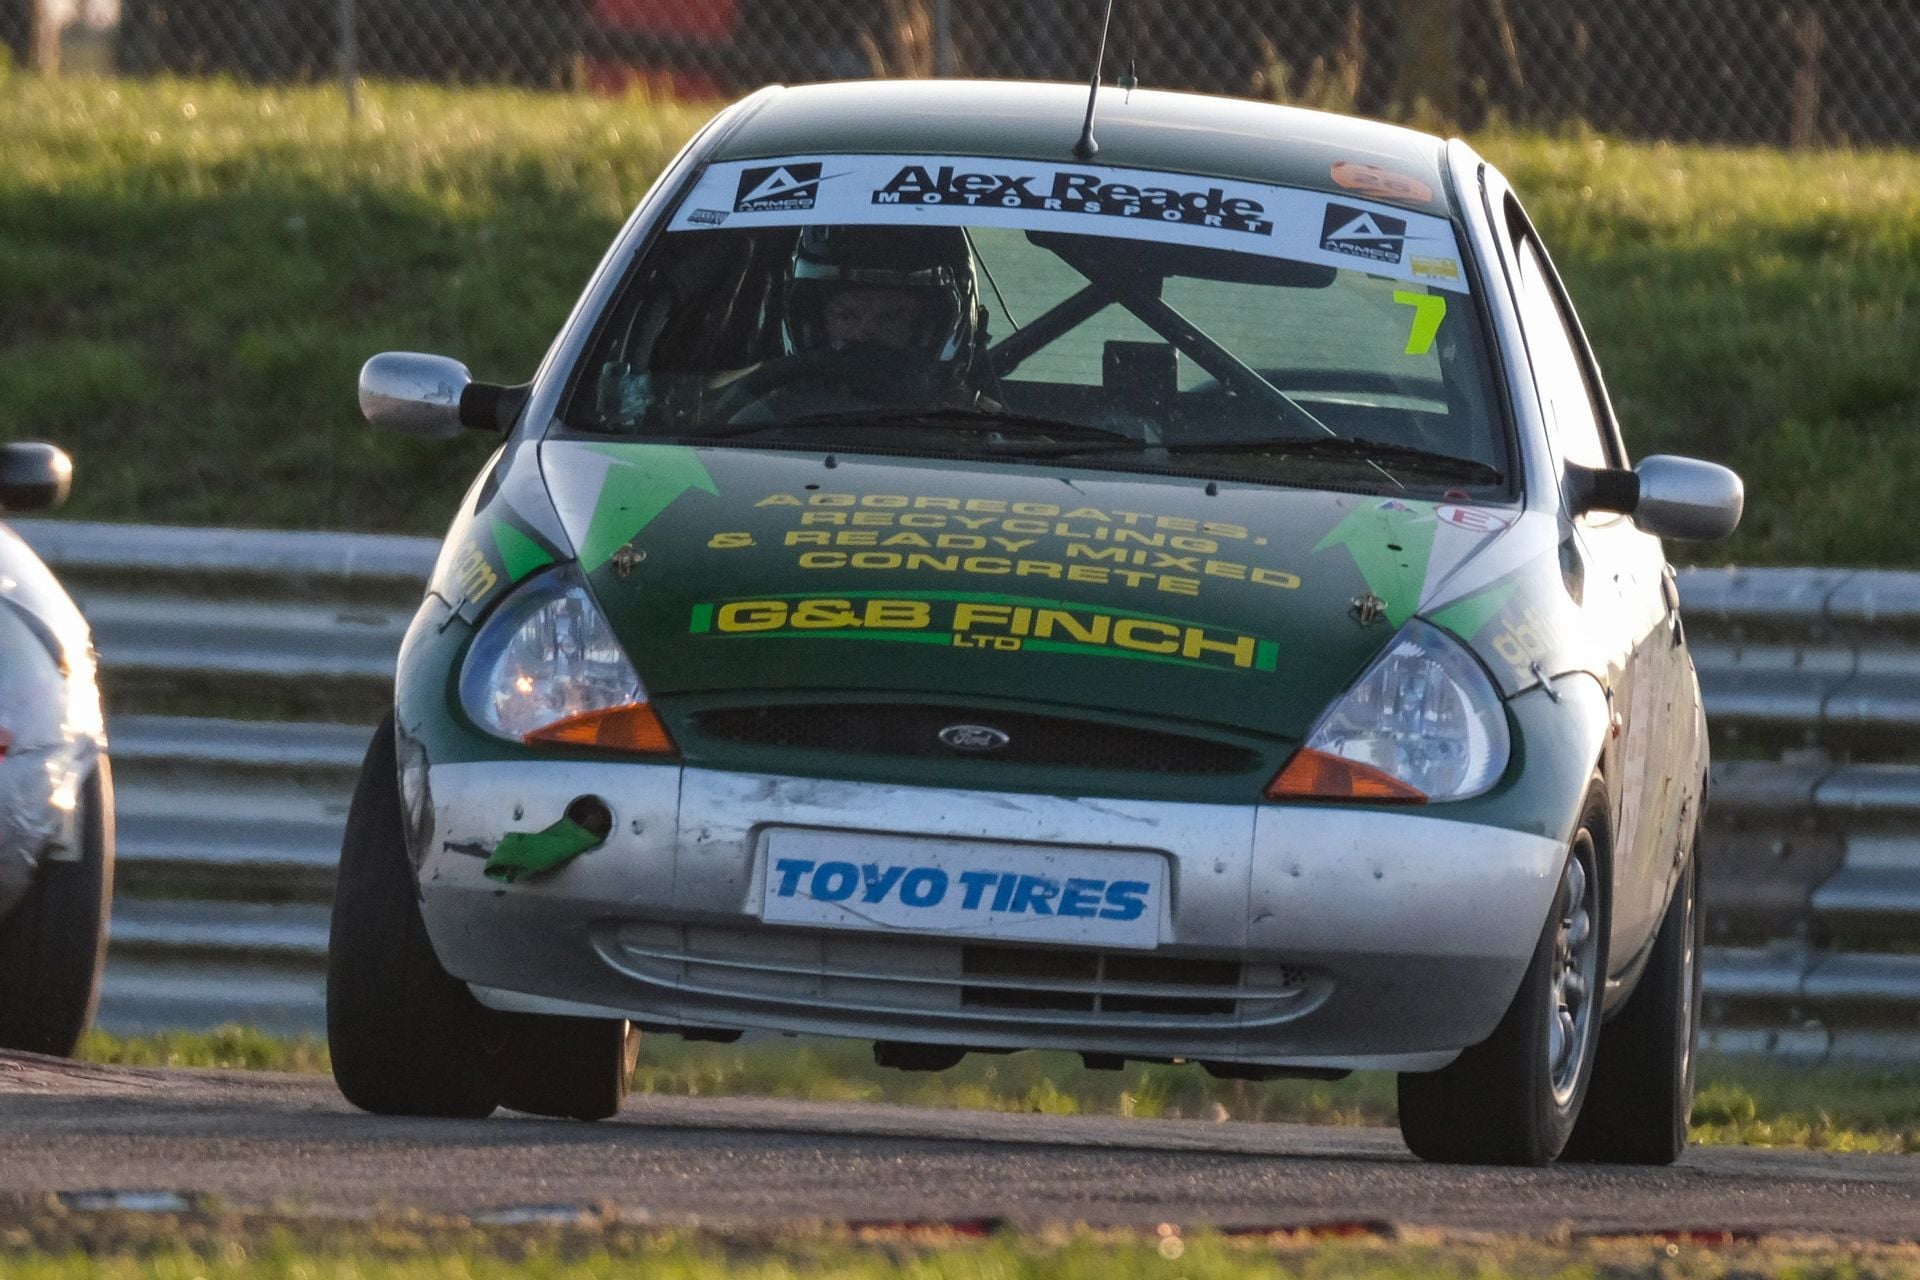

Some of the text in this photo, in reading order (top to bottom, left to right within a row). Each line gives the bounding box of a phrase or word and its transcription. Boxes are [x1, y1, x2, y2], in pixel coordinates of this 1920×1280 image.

[878, 190, 1262, 233] MOTORSPORT
[882, 164, 1265, 217] Alex Reade
[1392, 290, 1447, 354] 7
[800, 511, 1219, 554] RECYCLING
[707, 530, 1302, 589] & READY MIXED
[799, 551, 1202, 596] CONCRETE
[717, 599, 1256, 668] G&B FINCH
[952, 633, 1023, 652] LTD
[774, 858, 1151, 921] TOYO TIRES
